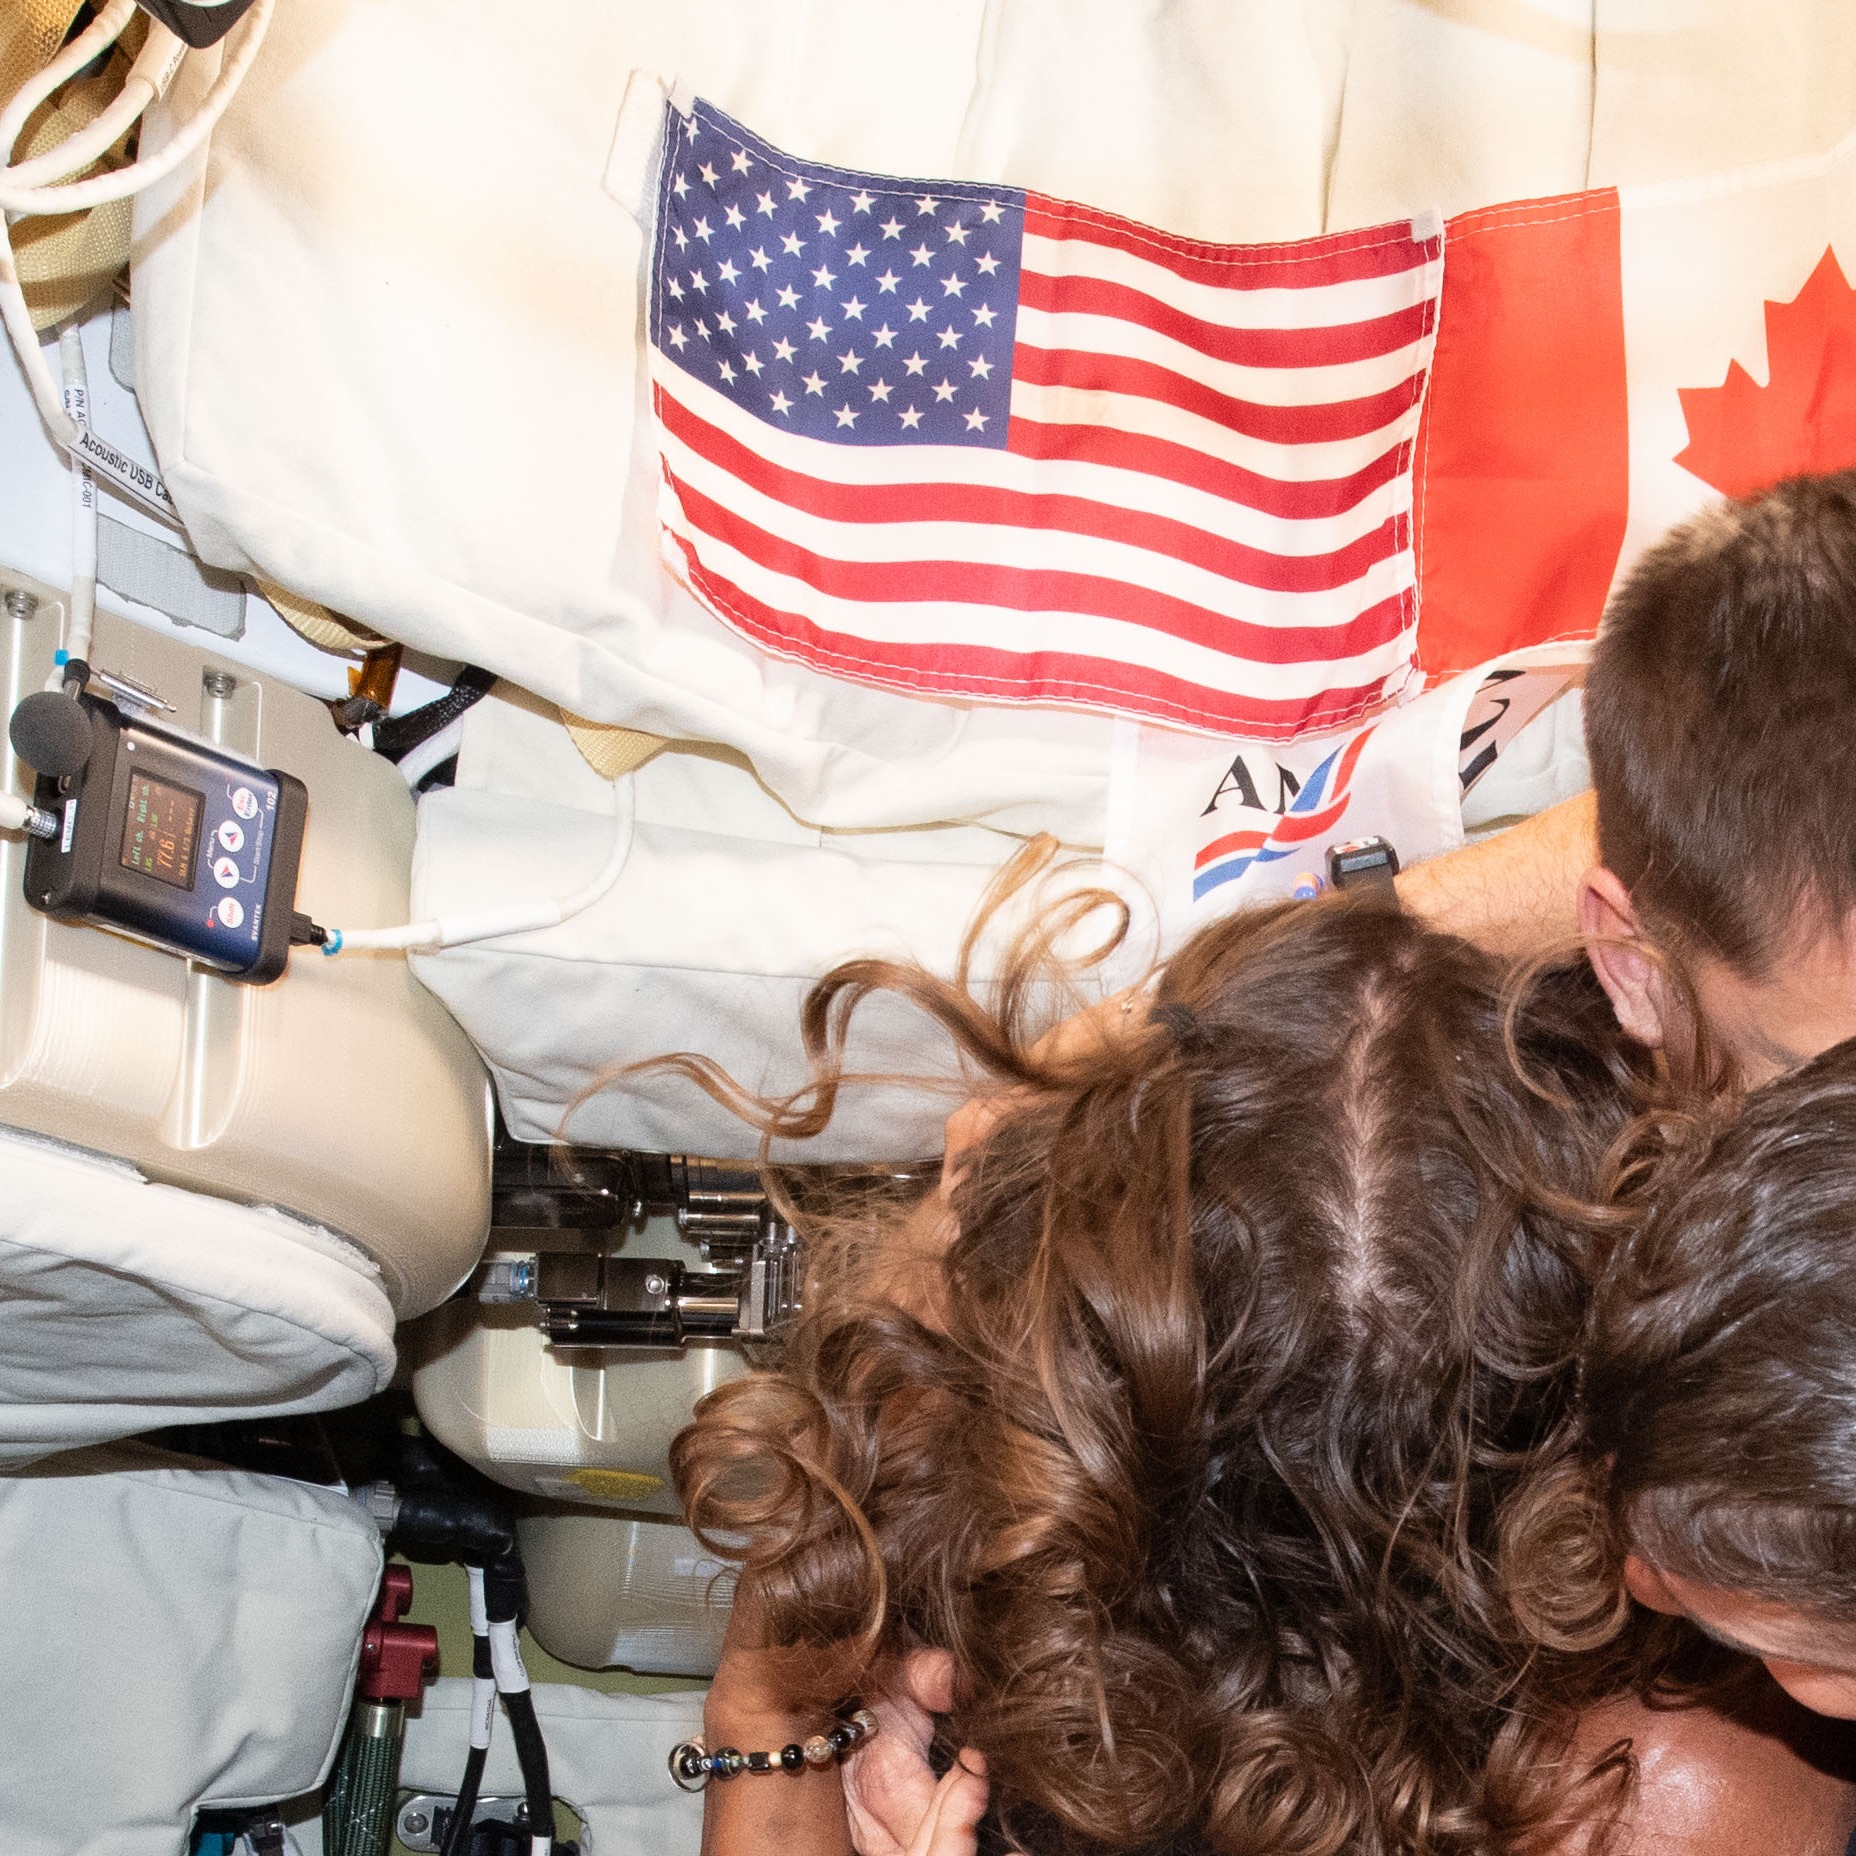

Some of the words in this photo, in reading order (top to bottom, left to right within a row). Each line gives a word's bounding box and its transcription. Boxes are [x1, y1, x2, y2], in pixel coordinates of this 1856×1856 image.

[80, 431, 129, 474] Acoustic
[129, 464, 154, 490] USB
[266, 791, 277, 812] 102
[131, 844, 143, 865] Left
[156, 838, 175, 869] 77.6
[226, 902, 236, 925] Shift
[251, 904, 262, 941] SVANTEK
